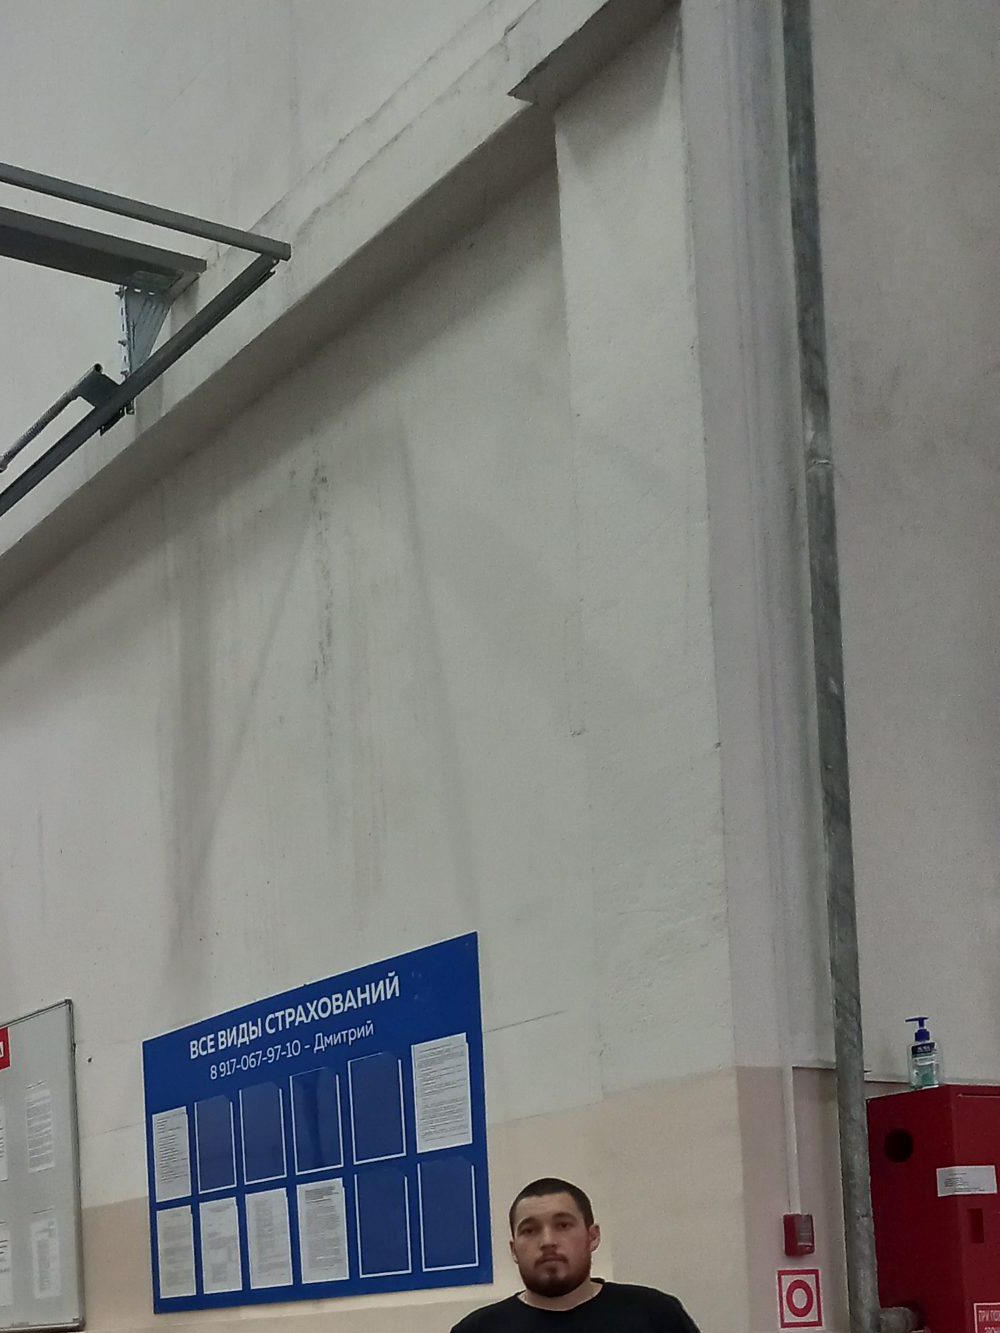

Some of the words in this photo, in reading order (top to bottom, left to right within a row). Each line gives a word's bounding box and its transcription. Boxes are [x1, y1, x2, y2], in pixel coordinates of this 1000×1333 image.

[189, 1033, 216, 1060] ВСЕ
[217, 1018, 263, 1050] ВИДЫ
[265, 971, 400, 1035] СТРАХОВАНИЙ
[209, 1065, 218, 1080] 8
[219, 1039, 301, 1077] 917-067-97-10
[313, 1019, 374, 1053] Дмитрий
